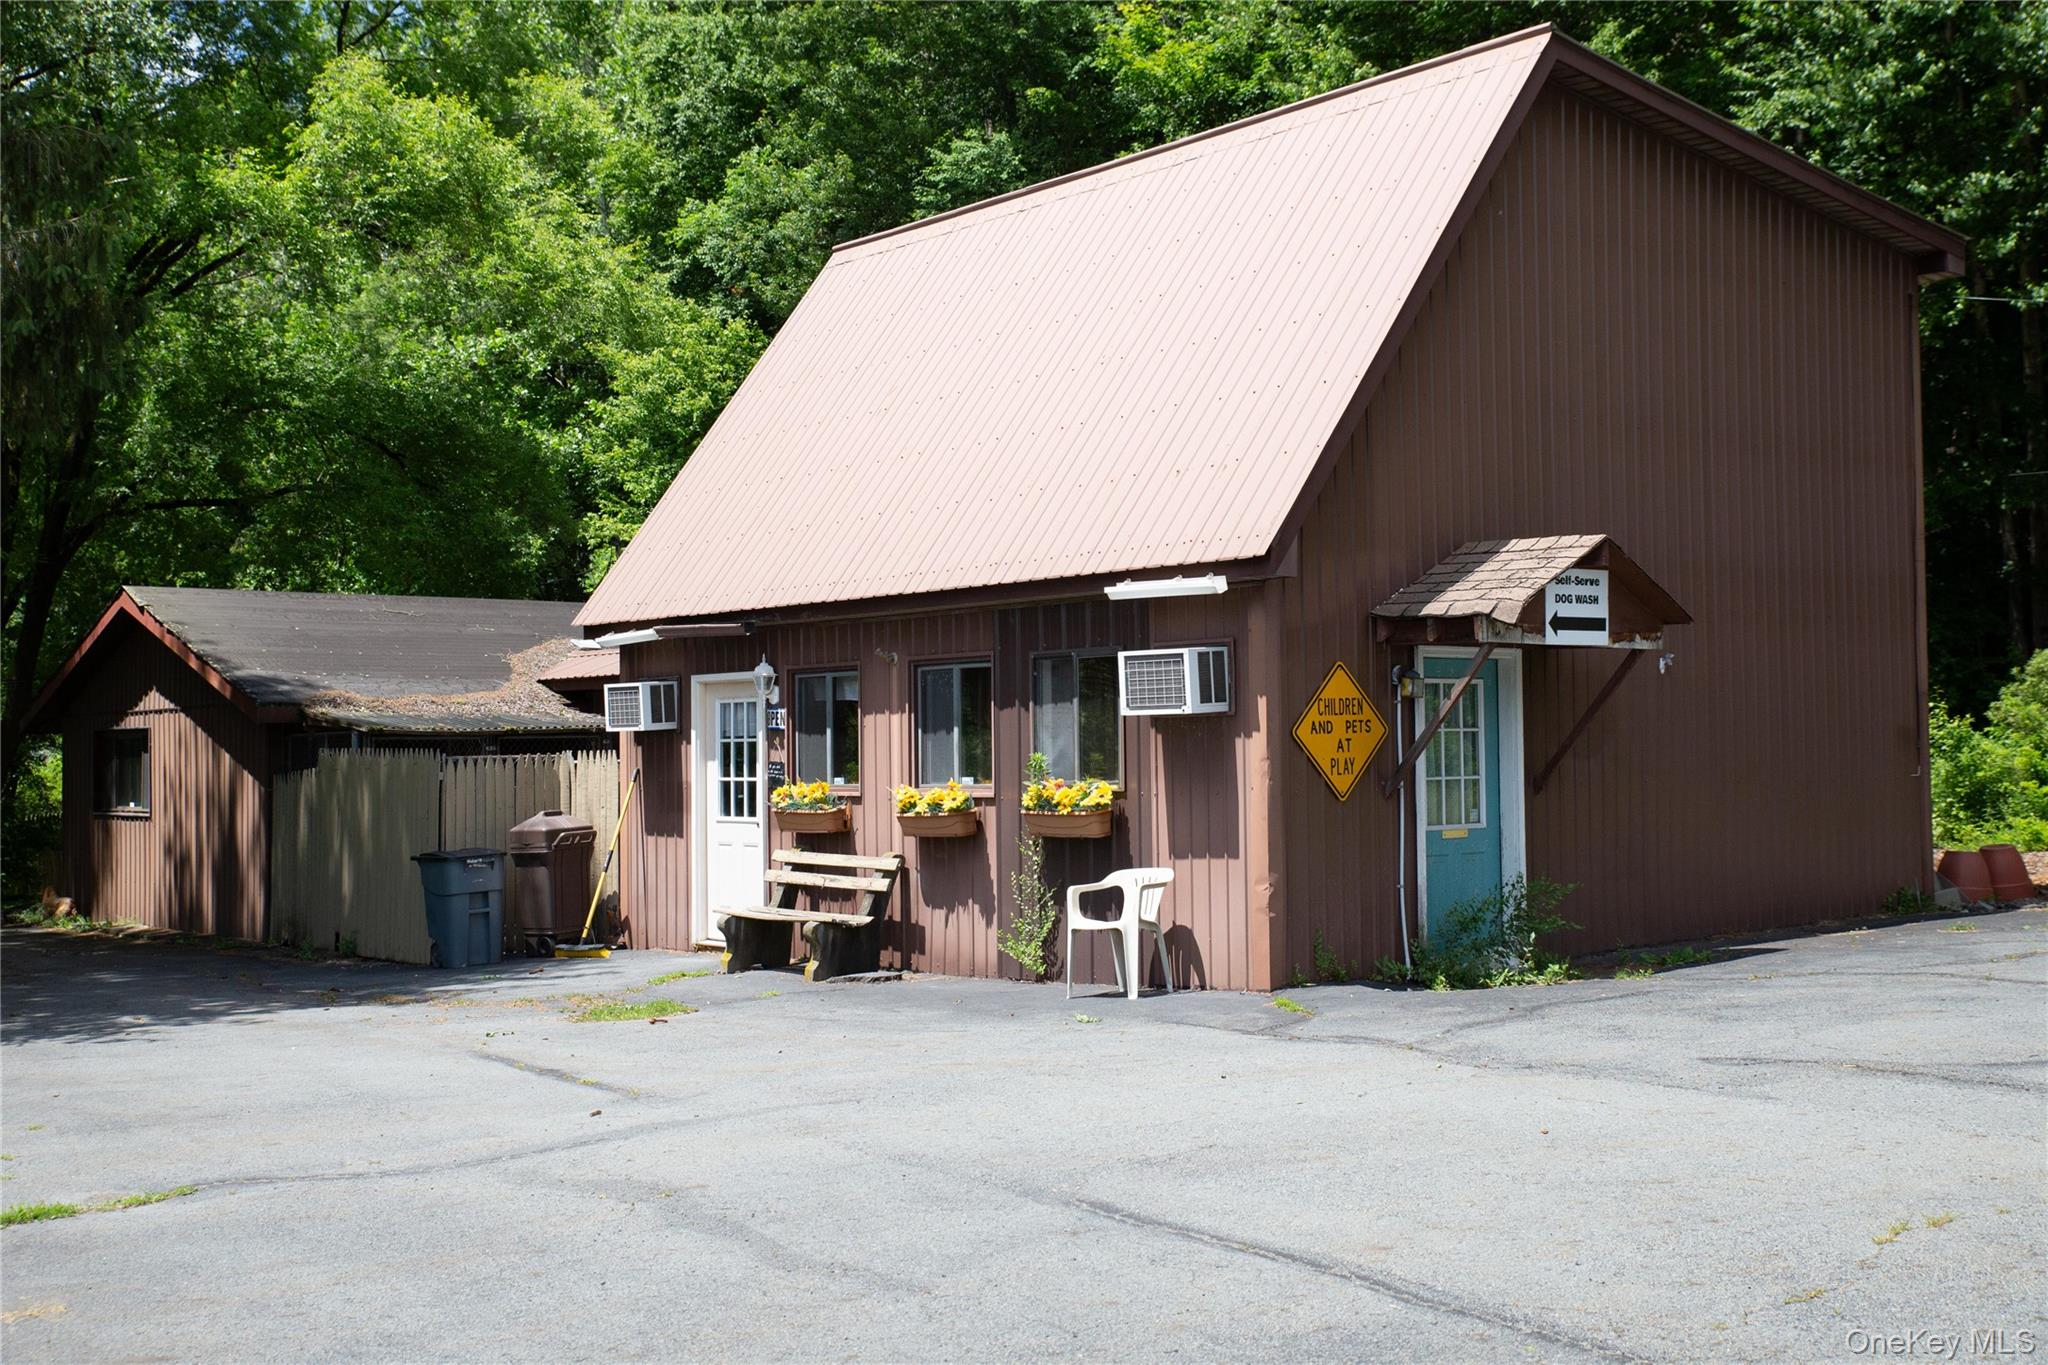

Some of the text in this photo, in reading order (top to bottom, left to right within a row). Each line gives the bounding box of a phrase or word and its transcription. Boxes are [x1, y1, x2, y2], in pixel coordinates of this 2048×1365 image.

[1555, 575, 1600, 586] Self-Serve
[1555, 594, 1599, 605] DOG WASH
[1317, 698, 1364, 716] CHILDREN
[1310, 719, 1372, 735] AND PETS
[1336, 738, 1352, 753] AT
[1330, 757, 1356, 776] PLAY
